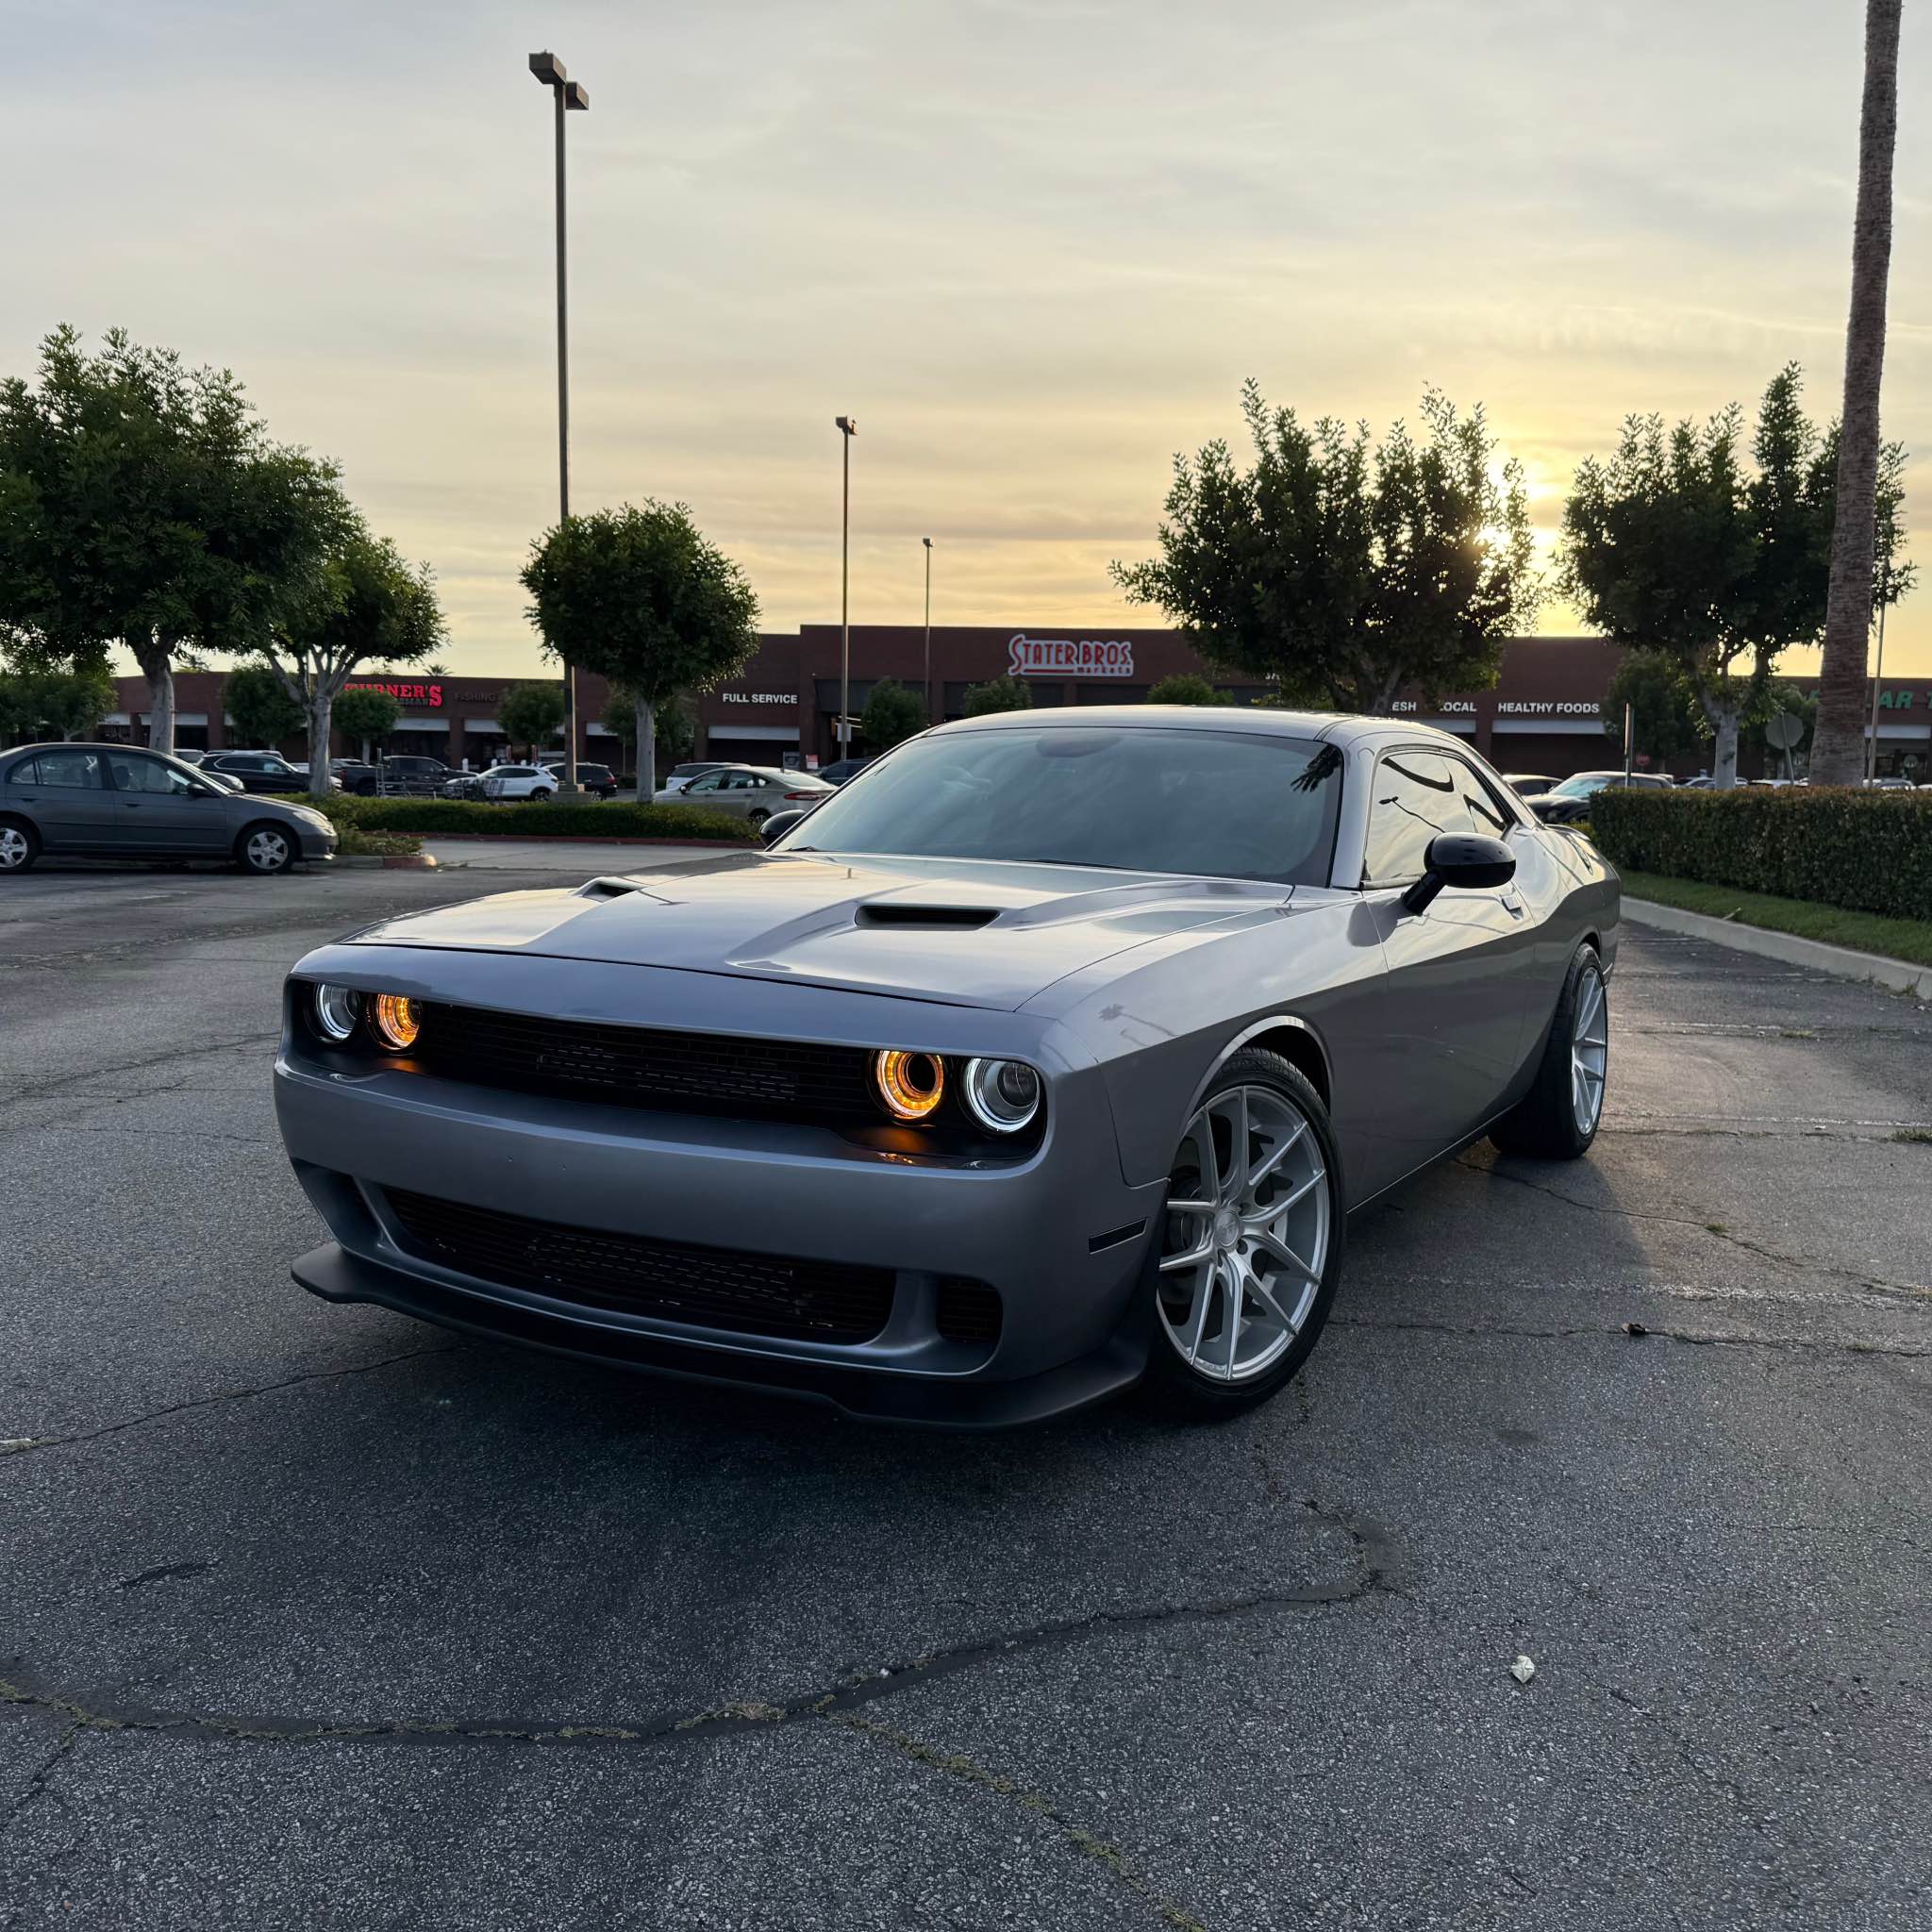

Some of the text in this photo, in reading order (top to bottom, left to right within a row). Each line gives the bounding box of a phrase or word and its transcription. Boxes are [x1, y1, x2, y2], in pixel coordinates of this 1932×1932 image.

[1010, 637, 1074, 673] STATER
[723, 693, 798, 704] FULL SERVICE
[1391, 701, 1417, 712] ESH
[1440, 702, 1477, 712] OCAL
[1497, 702, 1600, 714] HEALTHY FOODS
